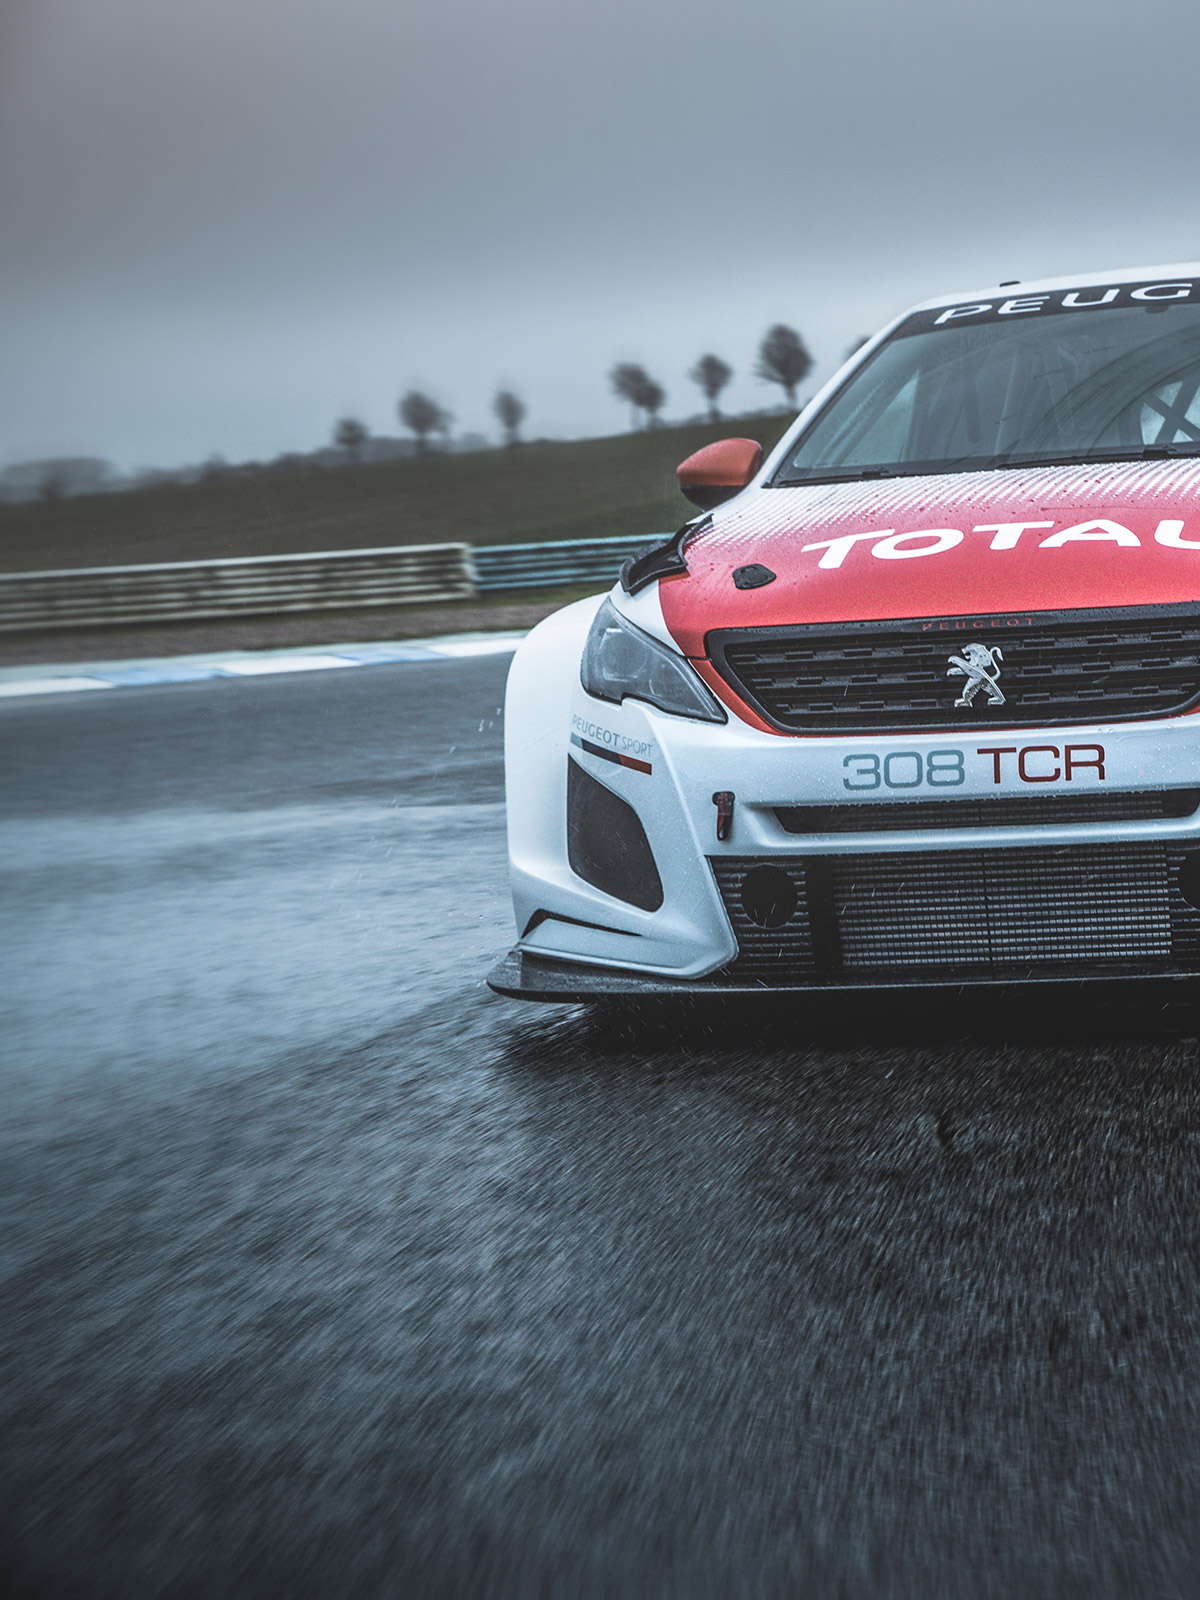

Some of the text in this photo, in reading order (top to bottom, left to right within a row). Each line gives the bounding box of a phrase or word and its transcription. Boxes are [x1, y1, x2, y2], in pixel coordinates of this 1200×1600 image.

[922, 617, 1036, 632] PEUGEOT
[572, 713, 653, 755] PEUGEOT SPORT
[843, 744, 1106, 791] 308 TCR
